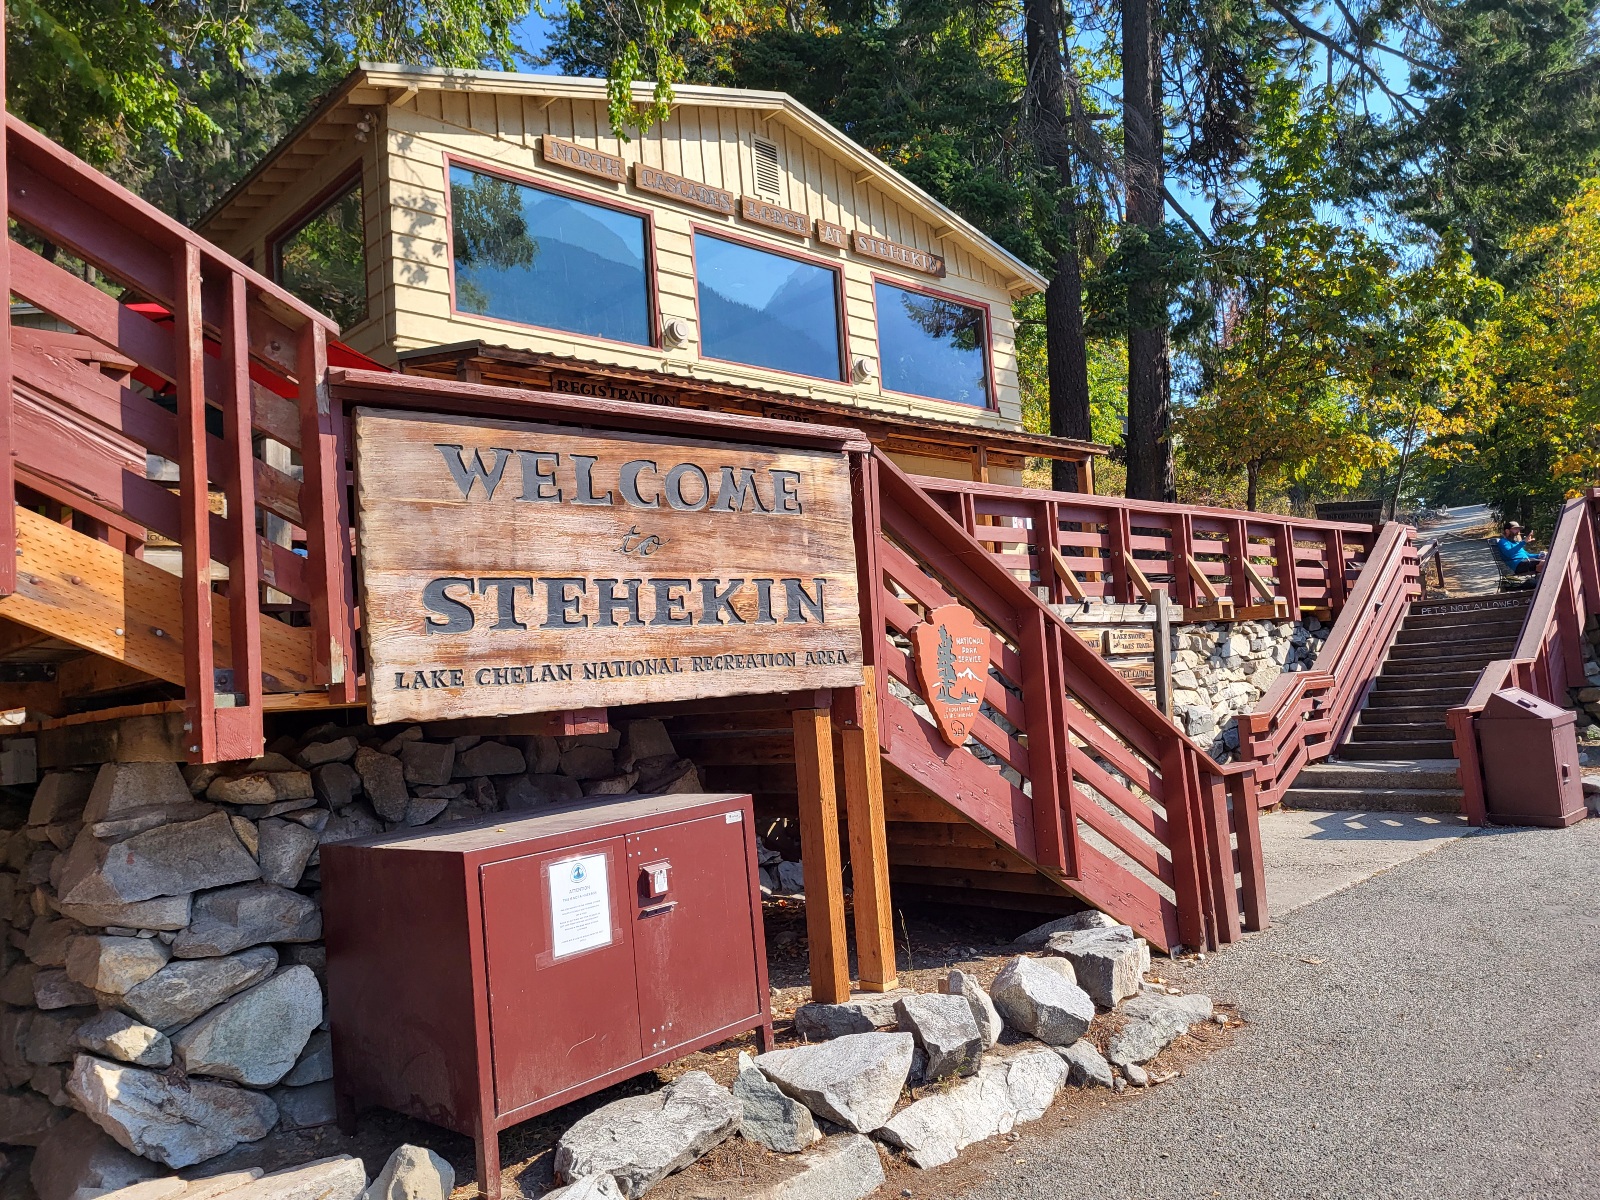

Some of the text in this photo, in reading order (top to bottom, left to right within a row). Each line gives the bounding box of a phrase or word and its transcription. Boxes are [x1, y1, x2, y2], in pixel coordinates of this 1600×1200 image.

[550, 141, 940, 273] NORTH CASCADES LODGE AT STEHEKIN
[557, 380, 676, 407] REGISTRATION
[433, 443, 804, 516] WELCOME
[613, 525, 671, 557] to
[424, 577, 828, 635] STEHEKIN
[1421, 606, 1447, 615] PETS
[1450, 604, 1470, 612] NOT
[1473, 600, 1520, 610] ALLOWED
[955, 636, 984, 645] NATIONAL
[961, 646, 978, 654] PARK
[394, 649, 850, 691] LAKE CHELAN NATIONAL RECREATION AREA
[957, 655, 982, 663] SERVICE
